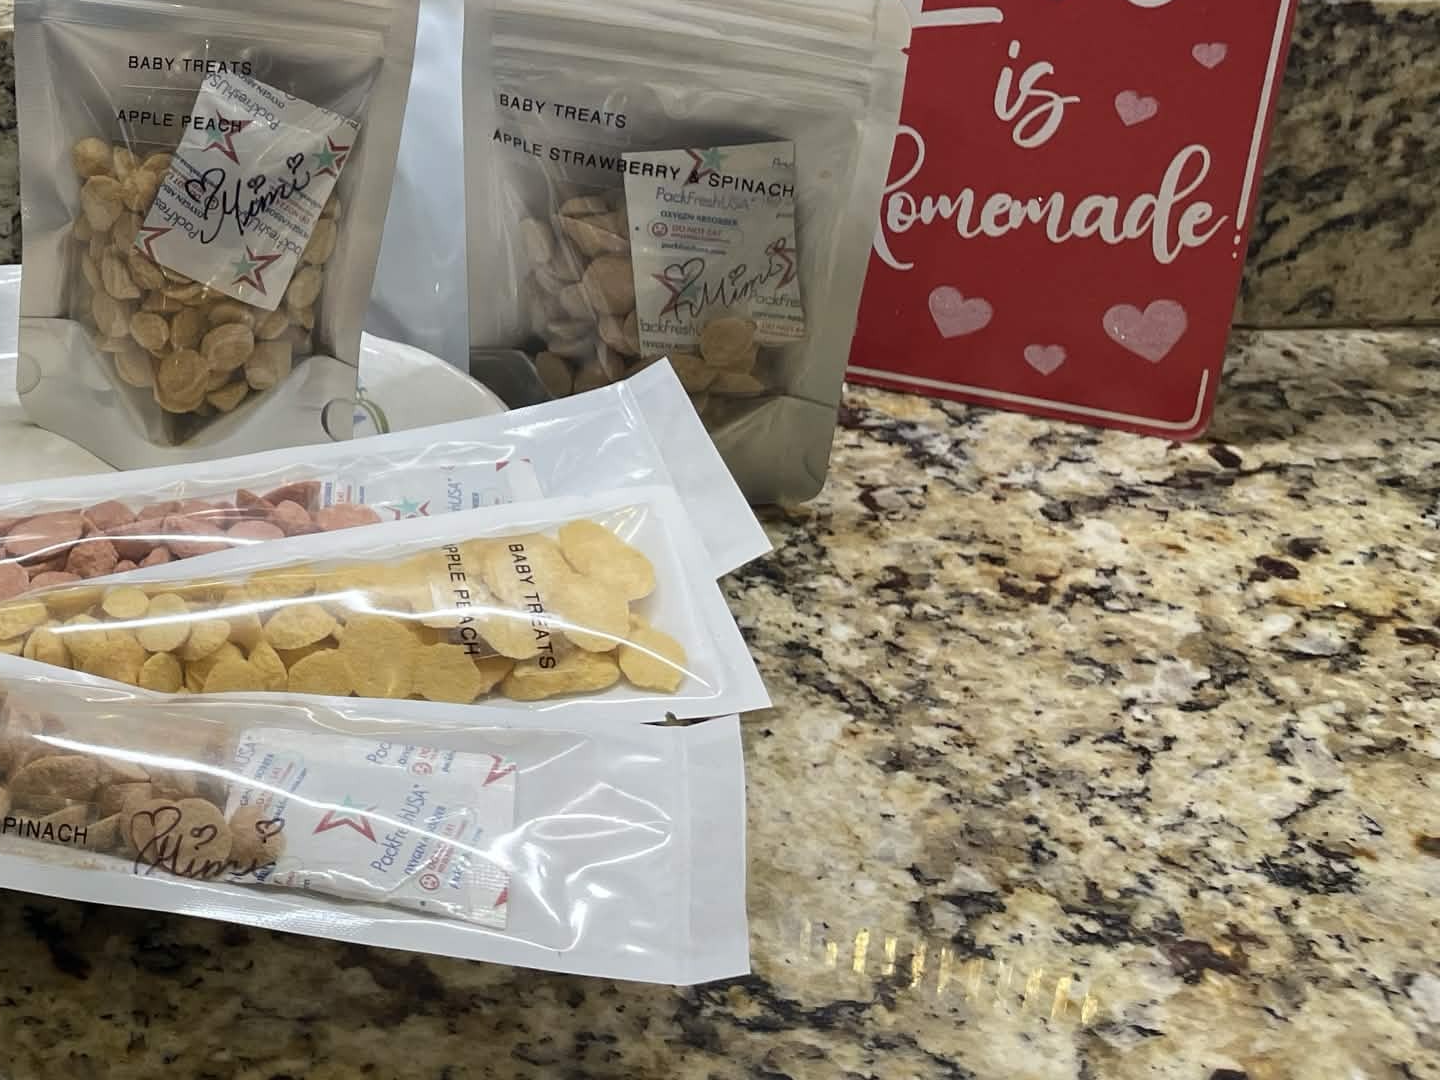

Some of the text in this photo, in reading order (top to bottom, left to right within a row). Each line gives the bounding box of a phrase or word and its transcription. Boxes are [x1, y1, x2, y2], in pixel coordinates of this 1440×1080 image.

[128, 55, 252, 75] BABY TREATS
[994, 39, 1081, 148] is
[117, 109, 243, 134] APPLE PEACH
[499, 93, 627, 128] BABY TREATS
[492, 129, 795, 199] APPLE STRAWBERRY & SPINACH
[453, 589, 481, 655] PEACH
[508, 543, 557, 670] BABY TREATS
